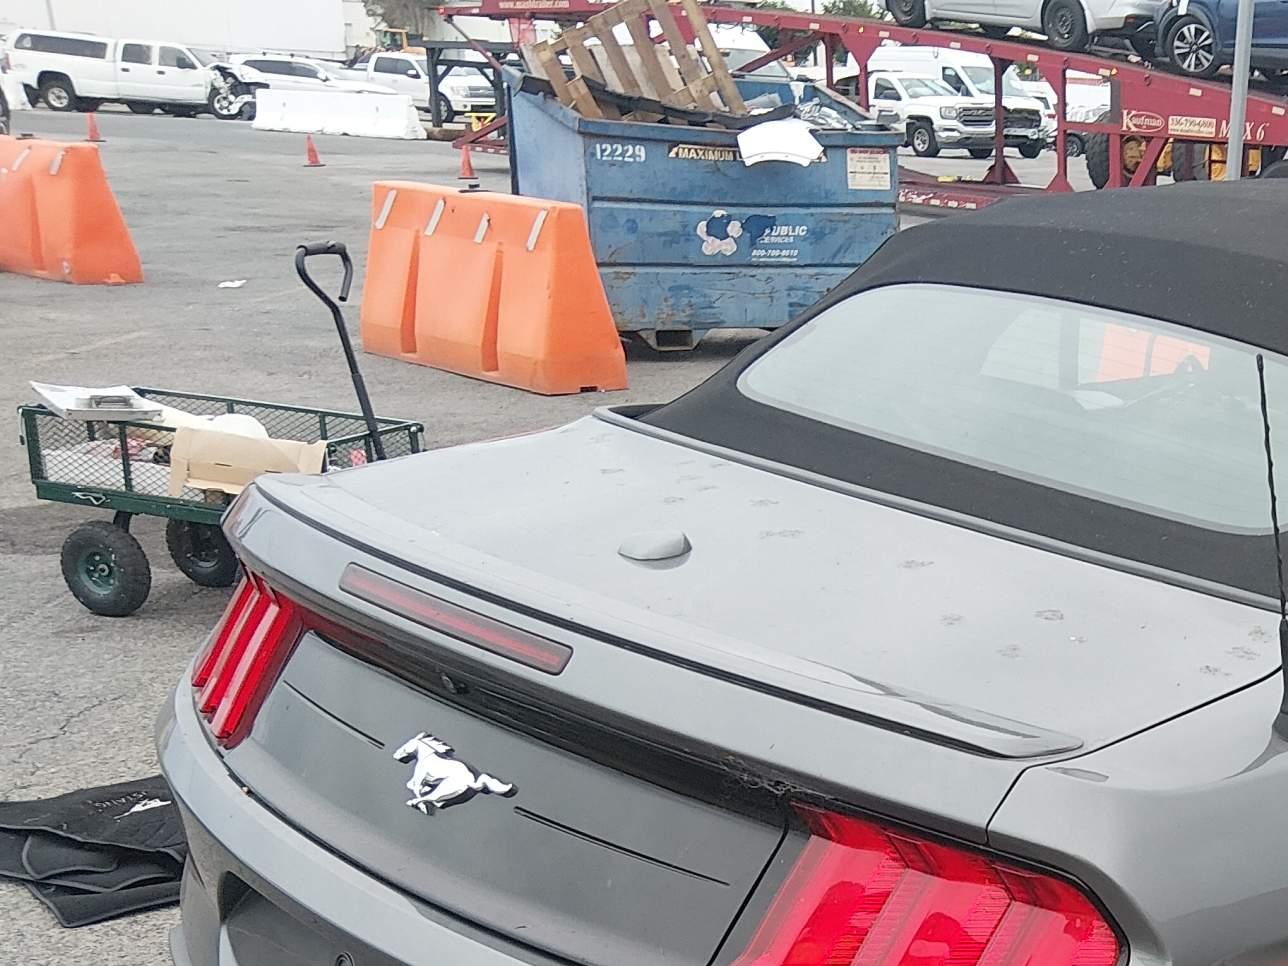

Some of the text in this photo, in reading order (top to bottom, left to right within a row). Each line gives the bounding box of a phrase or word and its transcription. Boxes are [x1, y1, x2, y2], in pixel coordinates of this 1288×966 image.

[1122, 109, 1162, 132] Kaufman
[1219, 119, 1255, 140] MX
[595, 143, 646, 162] 12229
[677, 147, 734, 161] MAXIMUM
